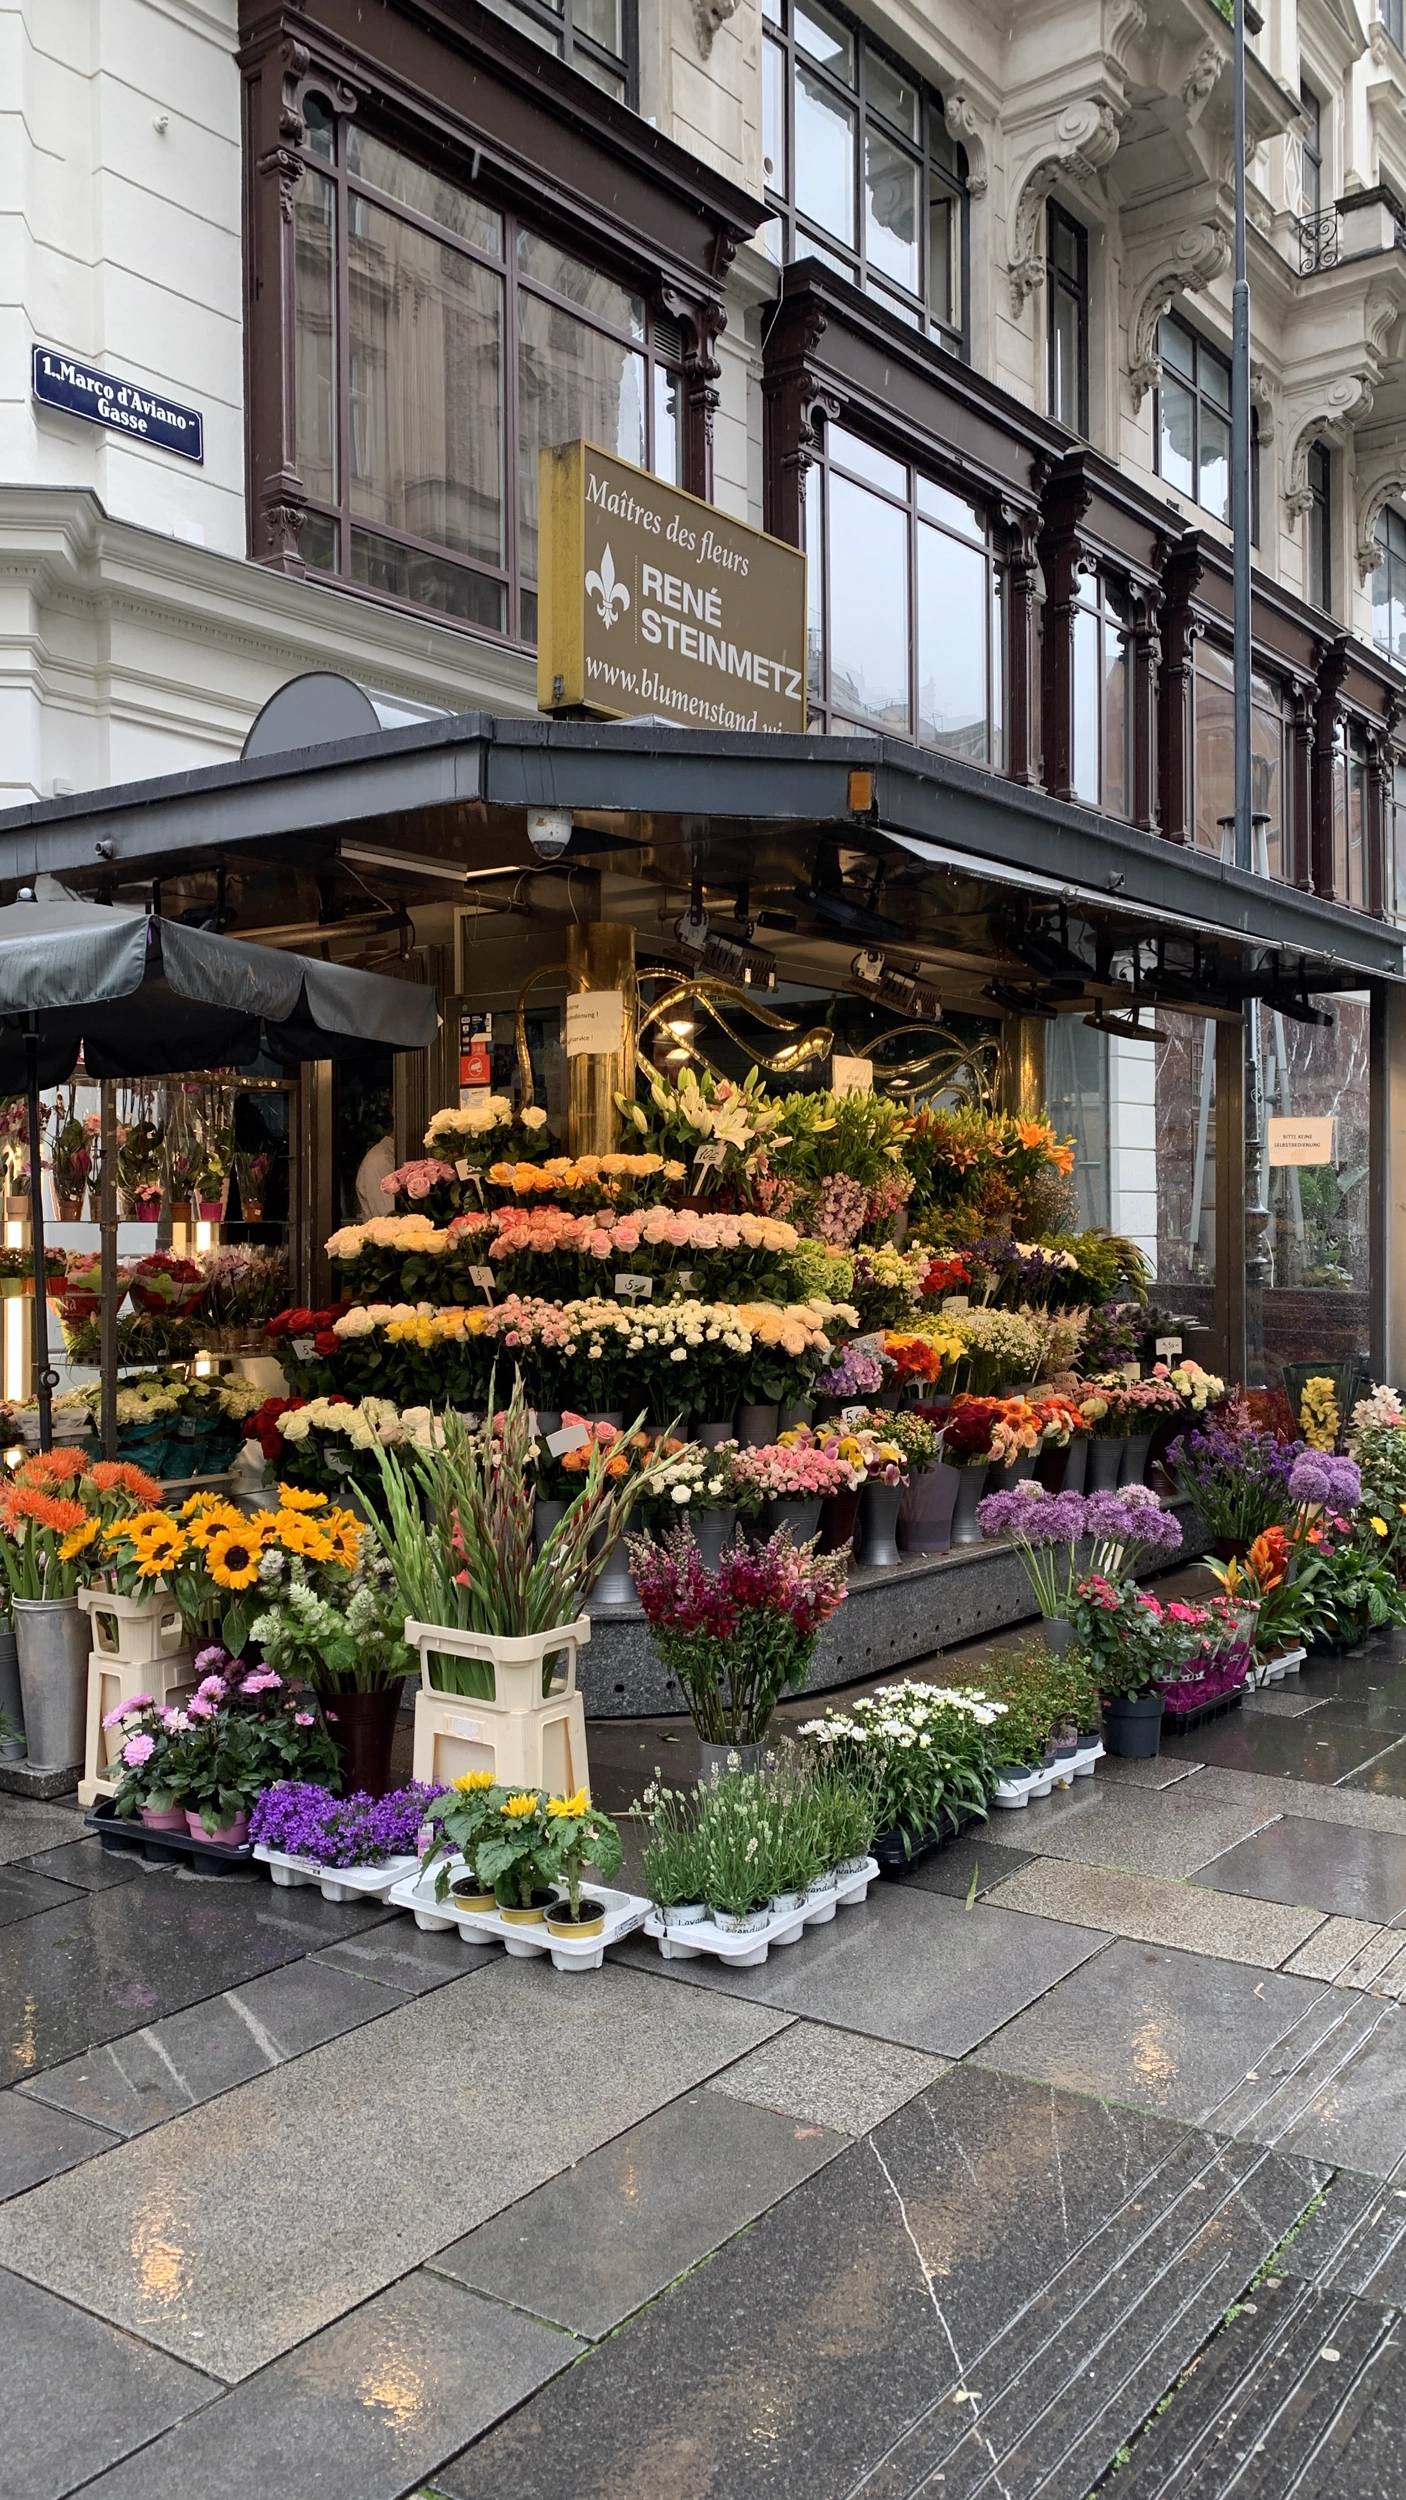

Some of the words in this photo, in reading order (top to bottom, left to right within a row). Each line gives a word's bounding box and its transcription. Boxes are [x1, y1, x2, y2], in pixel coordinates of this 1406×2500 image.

[97, 398, 148, 433] Gasse
[585, 472, 662, 534] Maîtres
[666, 514, 697, 551] des
[697, 531, 750, 577] fleurs
[642, 563, 723, 629] RENÉ
[641, 608, 802, 701] STEINMETZ
